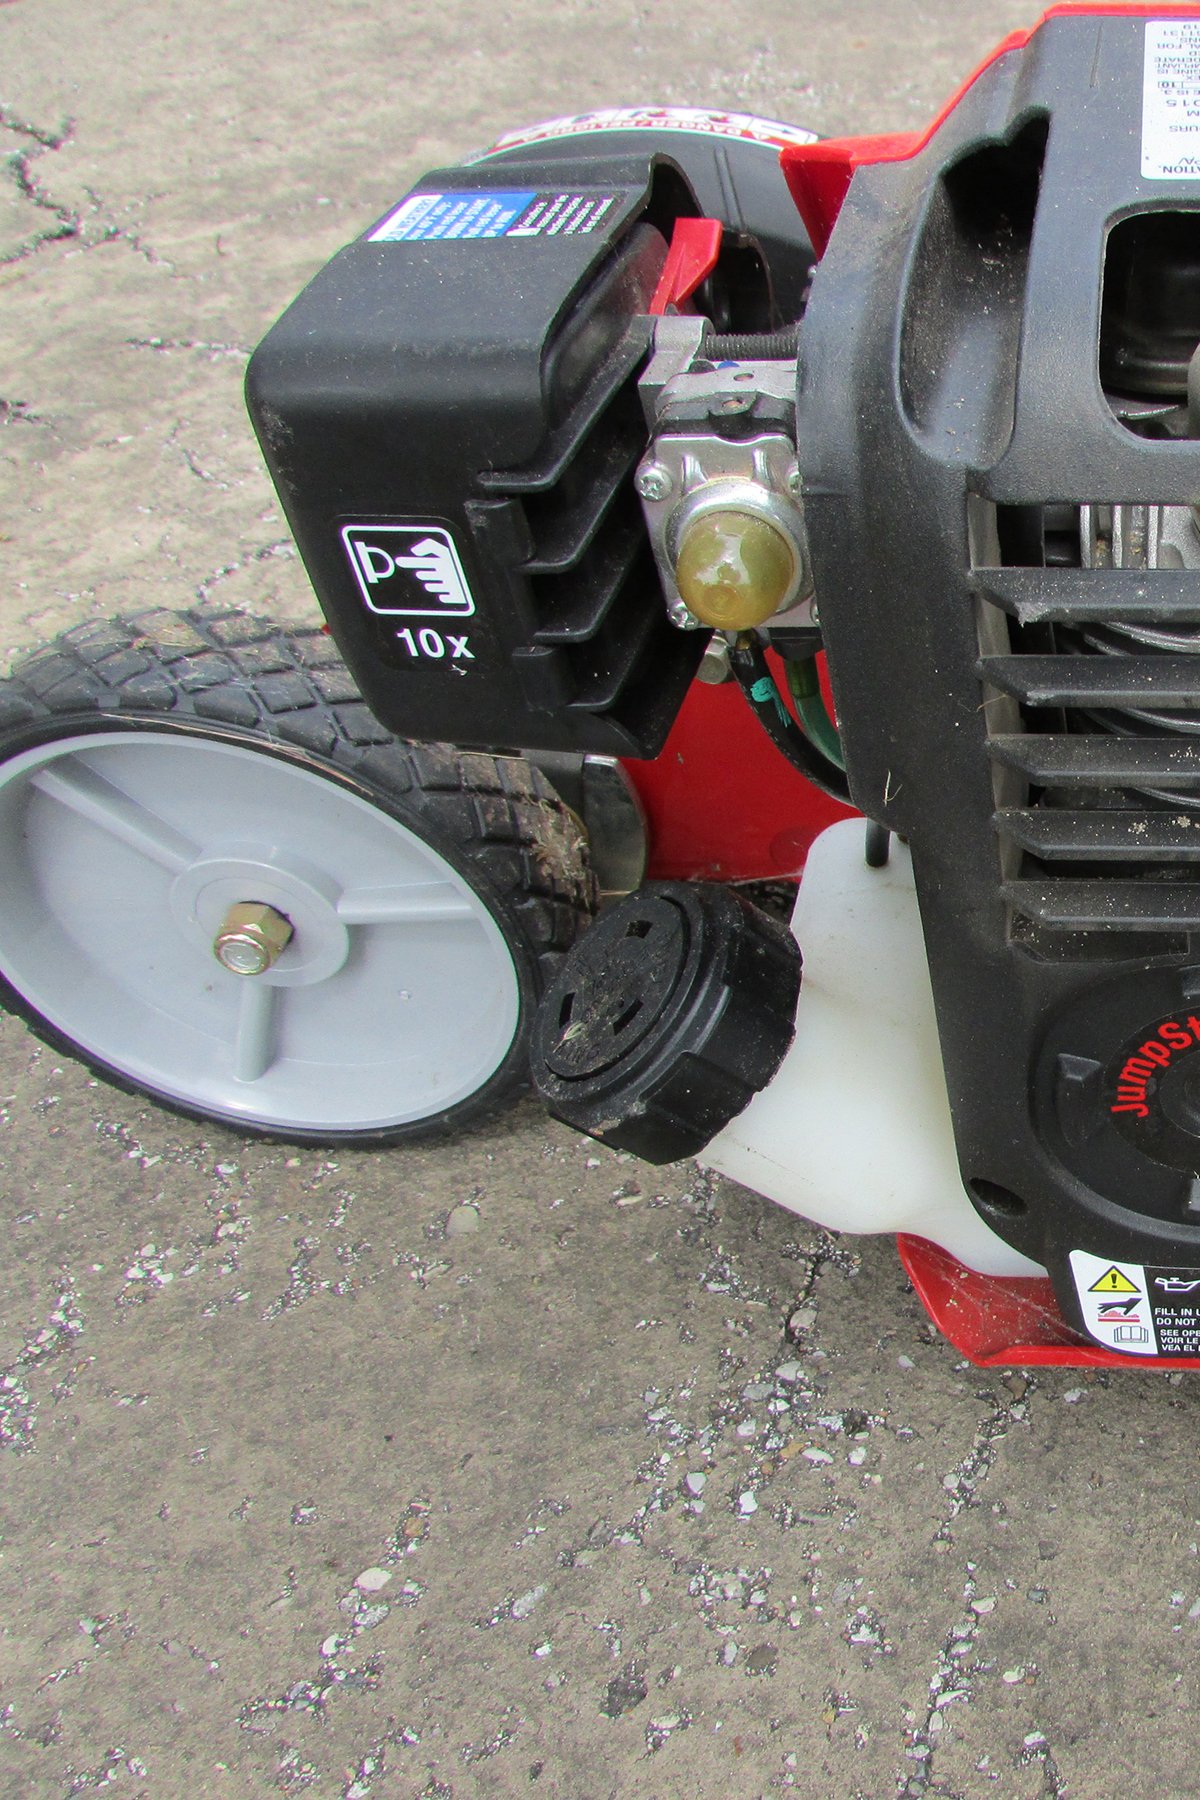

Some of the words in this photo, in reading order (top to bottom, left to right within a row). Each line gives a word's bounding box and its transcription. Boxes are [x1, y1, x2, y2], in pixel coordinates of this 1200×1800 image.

[1154, 1307, 1177, 1316] FILL
[1180, 1308, 1192, 1316] IN
[1157, 1317, 1172, 1326] DO
[1175, 1318, 1196, 1327] NOT
[1160, 1329, 1179, 1337] SEE
[1186, 1337, 1198, 1345] LE
[1161, 1344, 1181, 1352] VEA
[1184, 1344, 1195, 1352] EL
